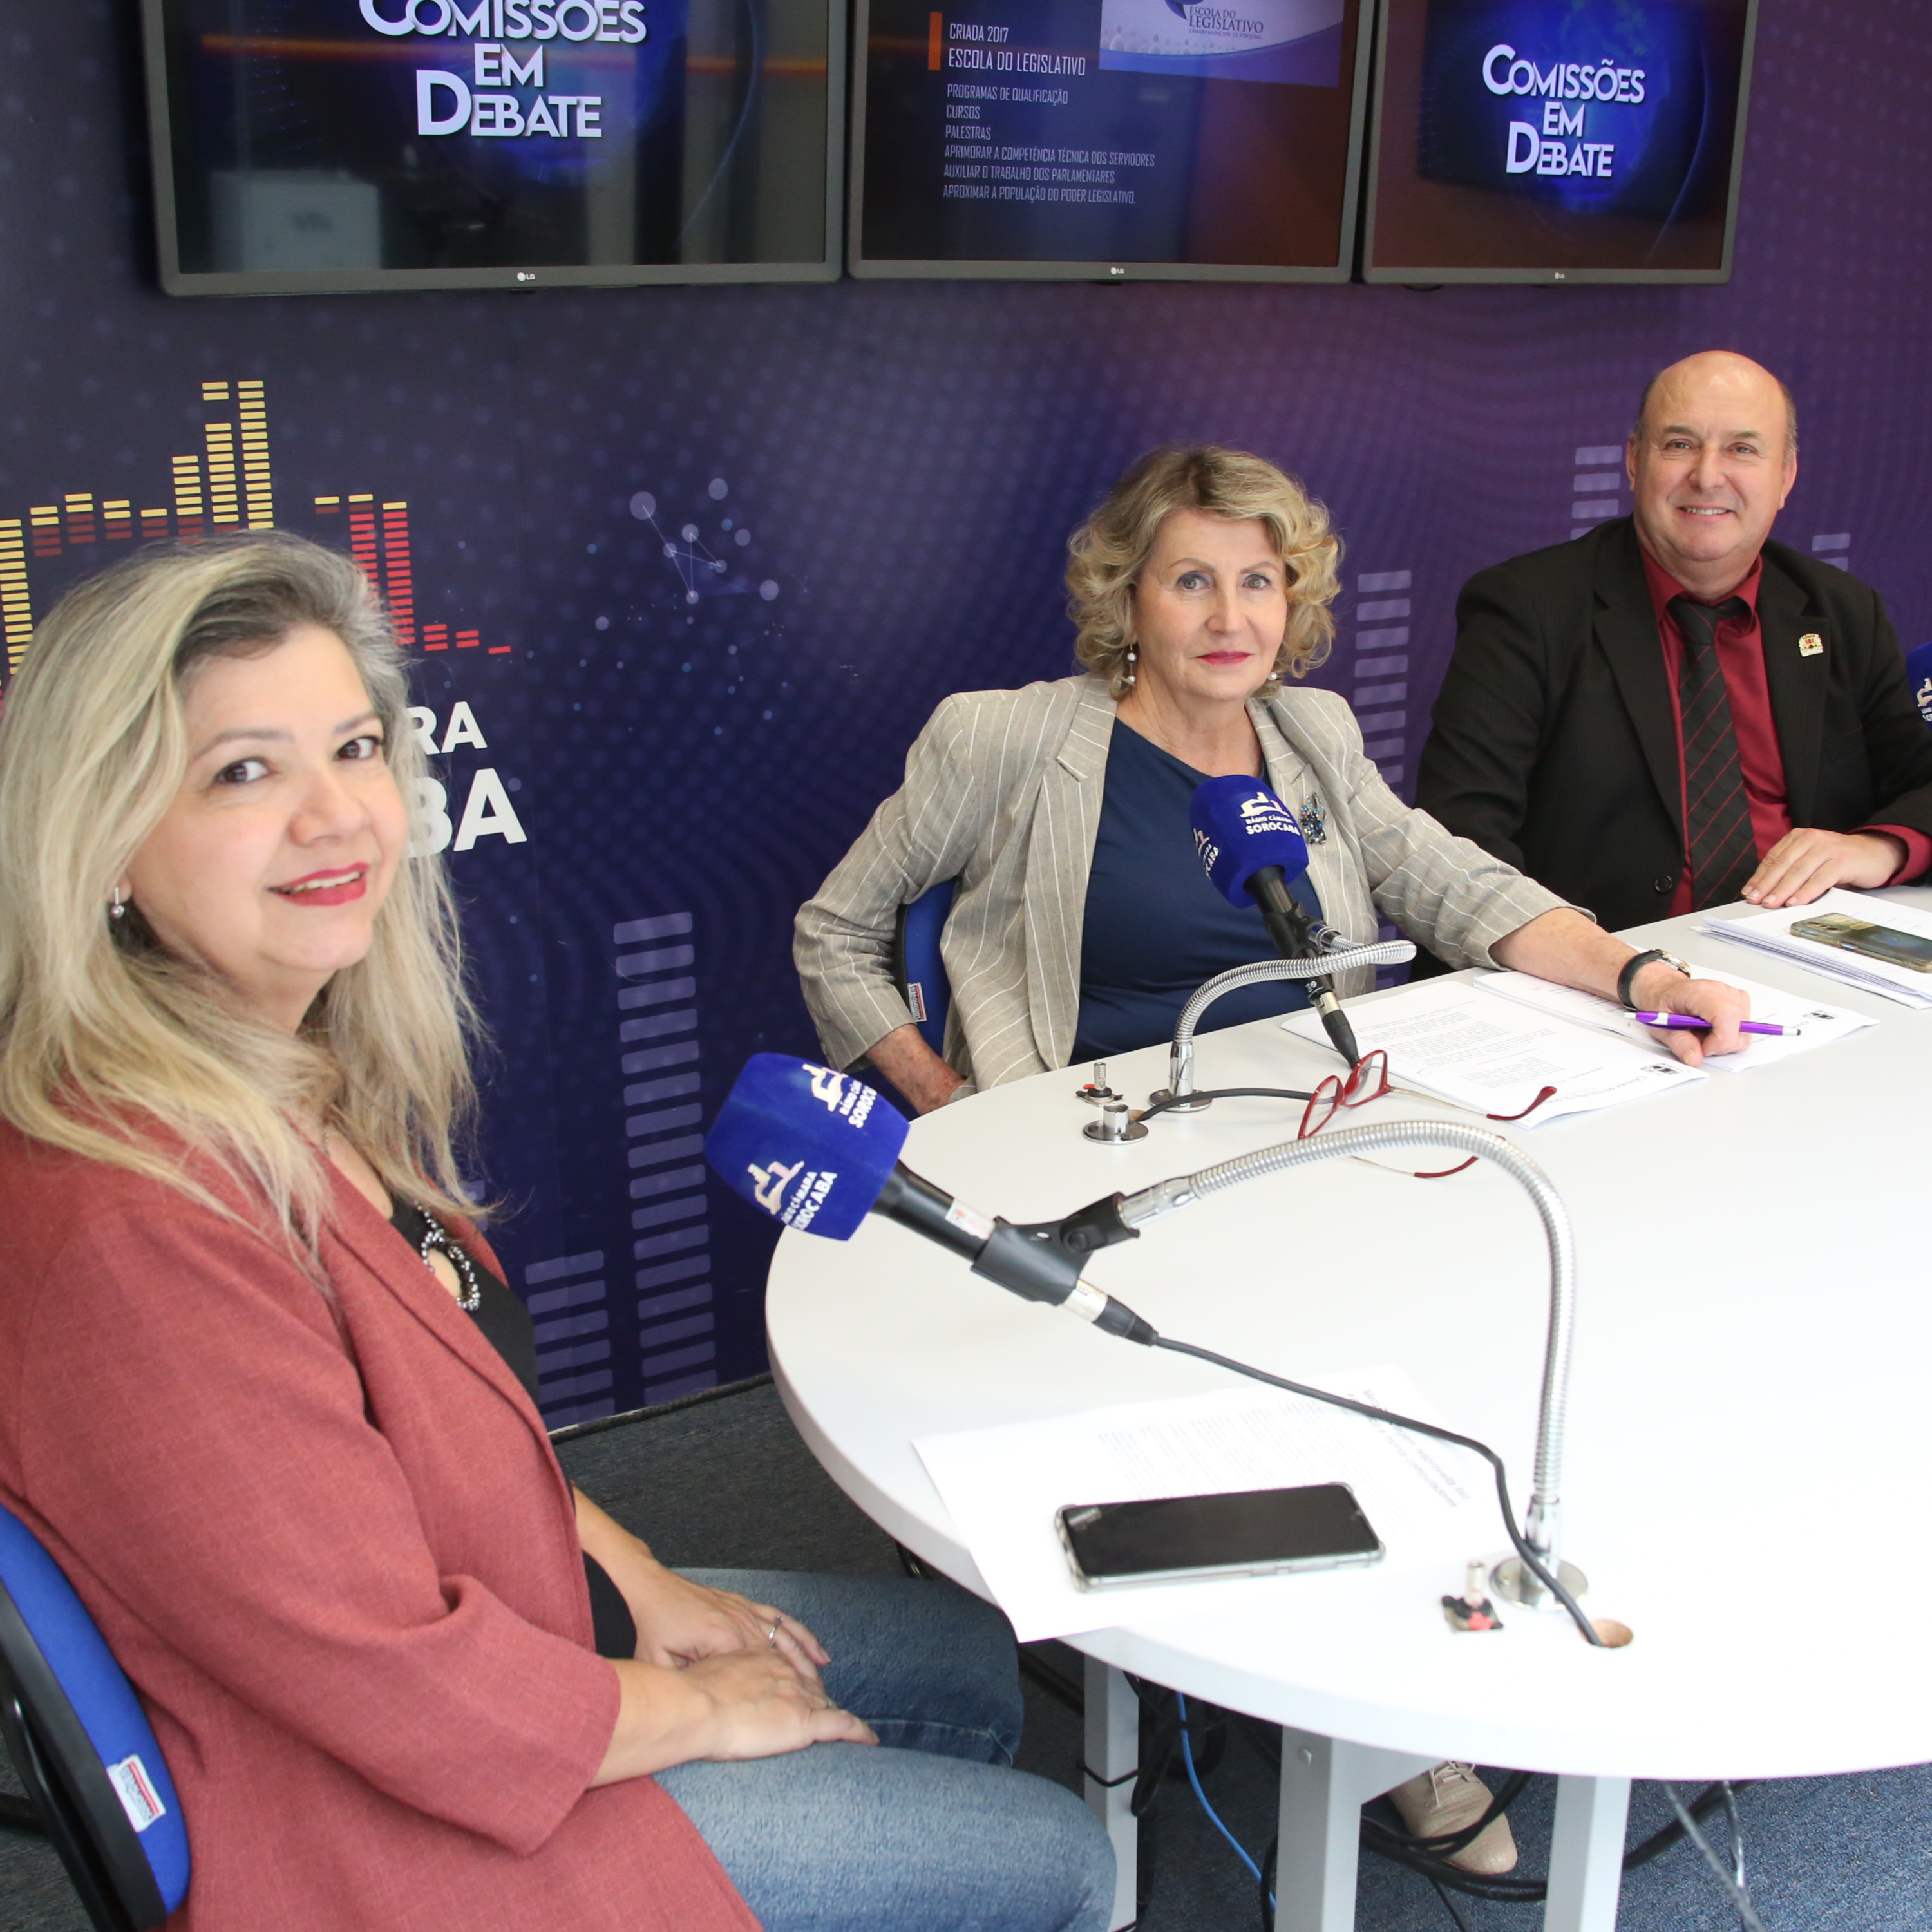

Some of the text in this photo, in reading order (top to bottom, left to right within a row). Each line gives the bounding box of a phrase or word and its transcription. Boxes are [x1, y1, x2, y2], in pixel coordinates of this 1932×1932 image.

[1189, 6, 1236, 19] ESCOLA DO
[949, 23, 1009, 43] CRIADA 2017
[1189, 15, 1264, 33] LEGISLATIVO
[475, 43, 544, 87] EM
[949, 48, 1086, 76] ESCOLA DO LEGISLATIVO
[1482, 44, 1645, 103] COMISSÕES
[416, 70, 602, 137] DEBATE
[947, 84, 1068, 106] PROGRAMAS DE QUALIFICAÇÃO
[946, 105, 980, 120] CURSOS
[1542, 101, 1584, 137] EM
[945, 125, 991, 140] PALESTRAS
[944, 145, 1155, 166] APRIMORAR A COMPETÊNCIA TÉCNICA DOS SERVIDORES
[1506, 121, 1614, 177] DEBATE
[944, 164, 1115, 184] AUXILIAR O TRABALHO DOS PARLAMENTARES
[943, 184, 990, 199] APROXIMAR
[991, 186, 997, 199] A
[999, 185, 1046, 203] POPULAÇÃO
[1048, 188, 1059, 201] DO
[1061, 189, 1086, 202] PODER
[407, 701, 488, 755] RA
[407, 768, 527, 858] BA
[1245, 817, 1268, 825] RÁDIO
[1246, 822, 1301, 837] SOROCABA
